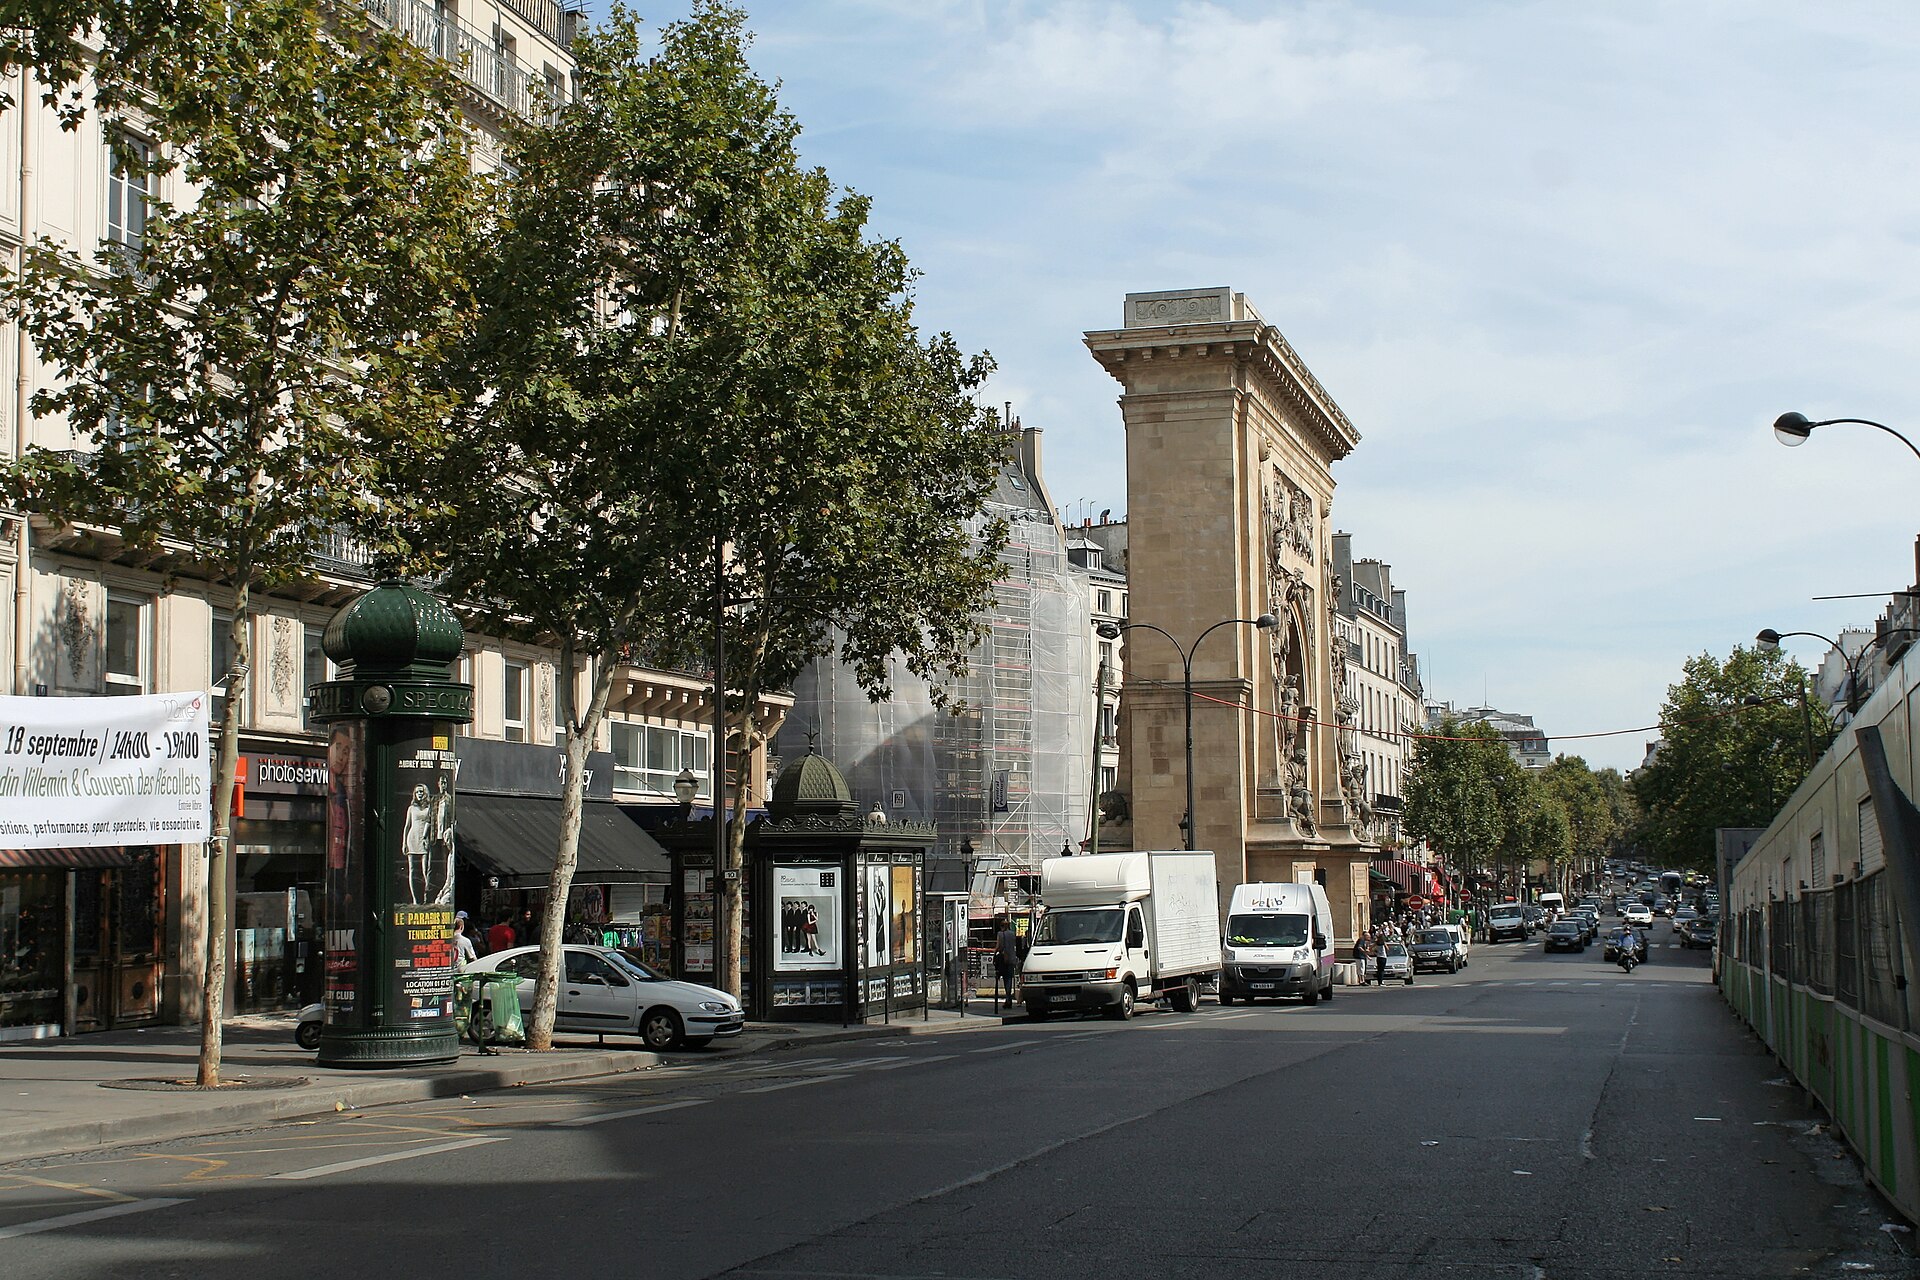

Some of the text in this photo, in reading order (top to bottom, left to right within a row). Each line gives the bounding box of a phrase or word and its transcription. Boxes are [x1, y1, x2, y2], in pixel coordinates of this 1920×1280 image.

[4, 726, 25, 755] 18
[27, 729, 98, 764] septembre
[98, 728, 109, 764] /
[110, 731, 150, 759] 14h00
[163, 731, 200, 759] 19h00
[0, 766, 201, 797] din Villemin & Couvent des Récollets
[33, 820, 90, 838] performances,
[92, 820, 110, 837] sport,
[112, 818, 148, 836] spectacles,
[150, 817, 160, 831] vie
[162, 817, 203, 832] associative.
[395, 913, 405, 925] LE
[408, 912, 440, 925] PARADIS
[408, 930, 439, 940] TENNESSEE
[405, 980, 434, 988] LOCATION
[336, 991, 355, 1000] CLUB
